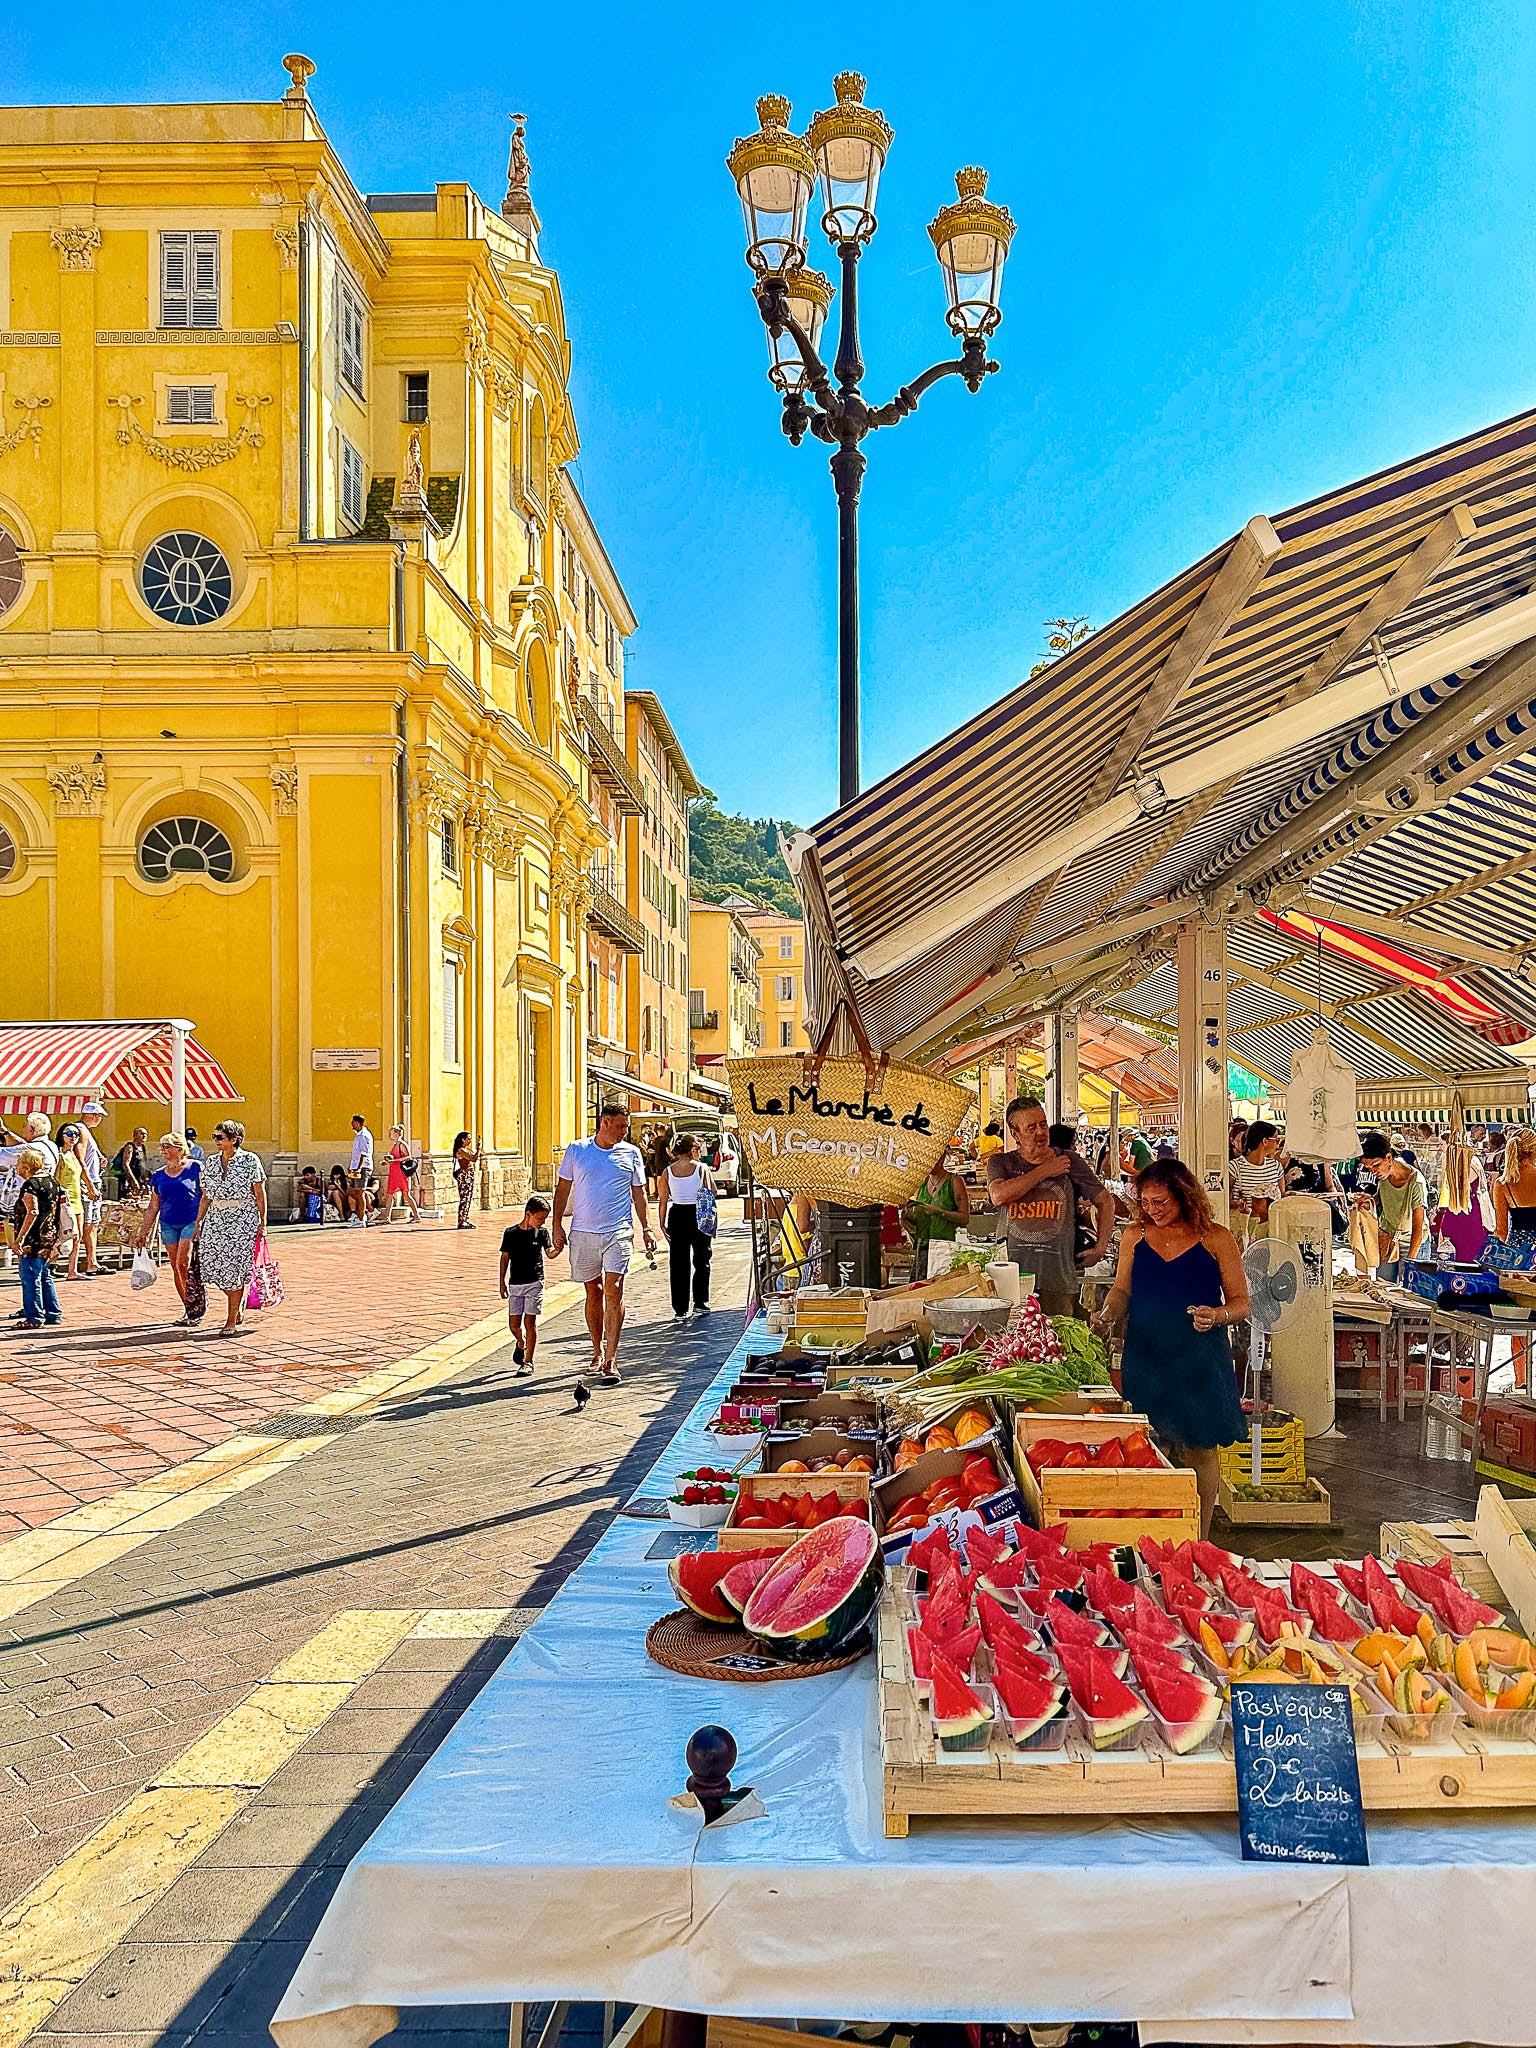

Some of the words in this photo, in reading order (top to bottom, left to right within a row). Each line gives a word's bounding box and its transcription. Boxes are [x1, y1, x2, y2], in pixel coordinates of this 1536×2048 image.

[1203, 970, 1221, 981] 46
[1065, 1031, 1075, 1039] 45
[748, 1082, 785, 1116] Le
[901, 1102, 933, 1136] de
[1236, 1690, 1336, 1726] Pastèque
[1243, 1719, 1309, 1749] Melon
[1293, 1781, 1314, 1803] la
